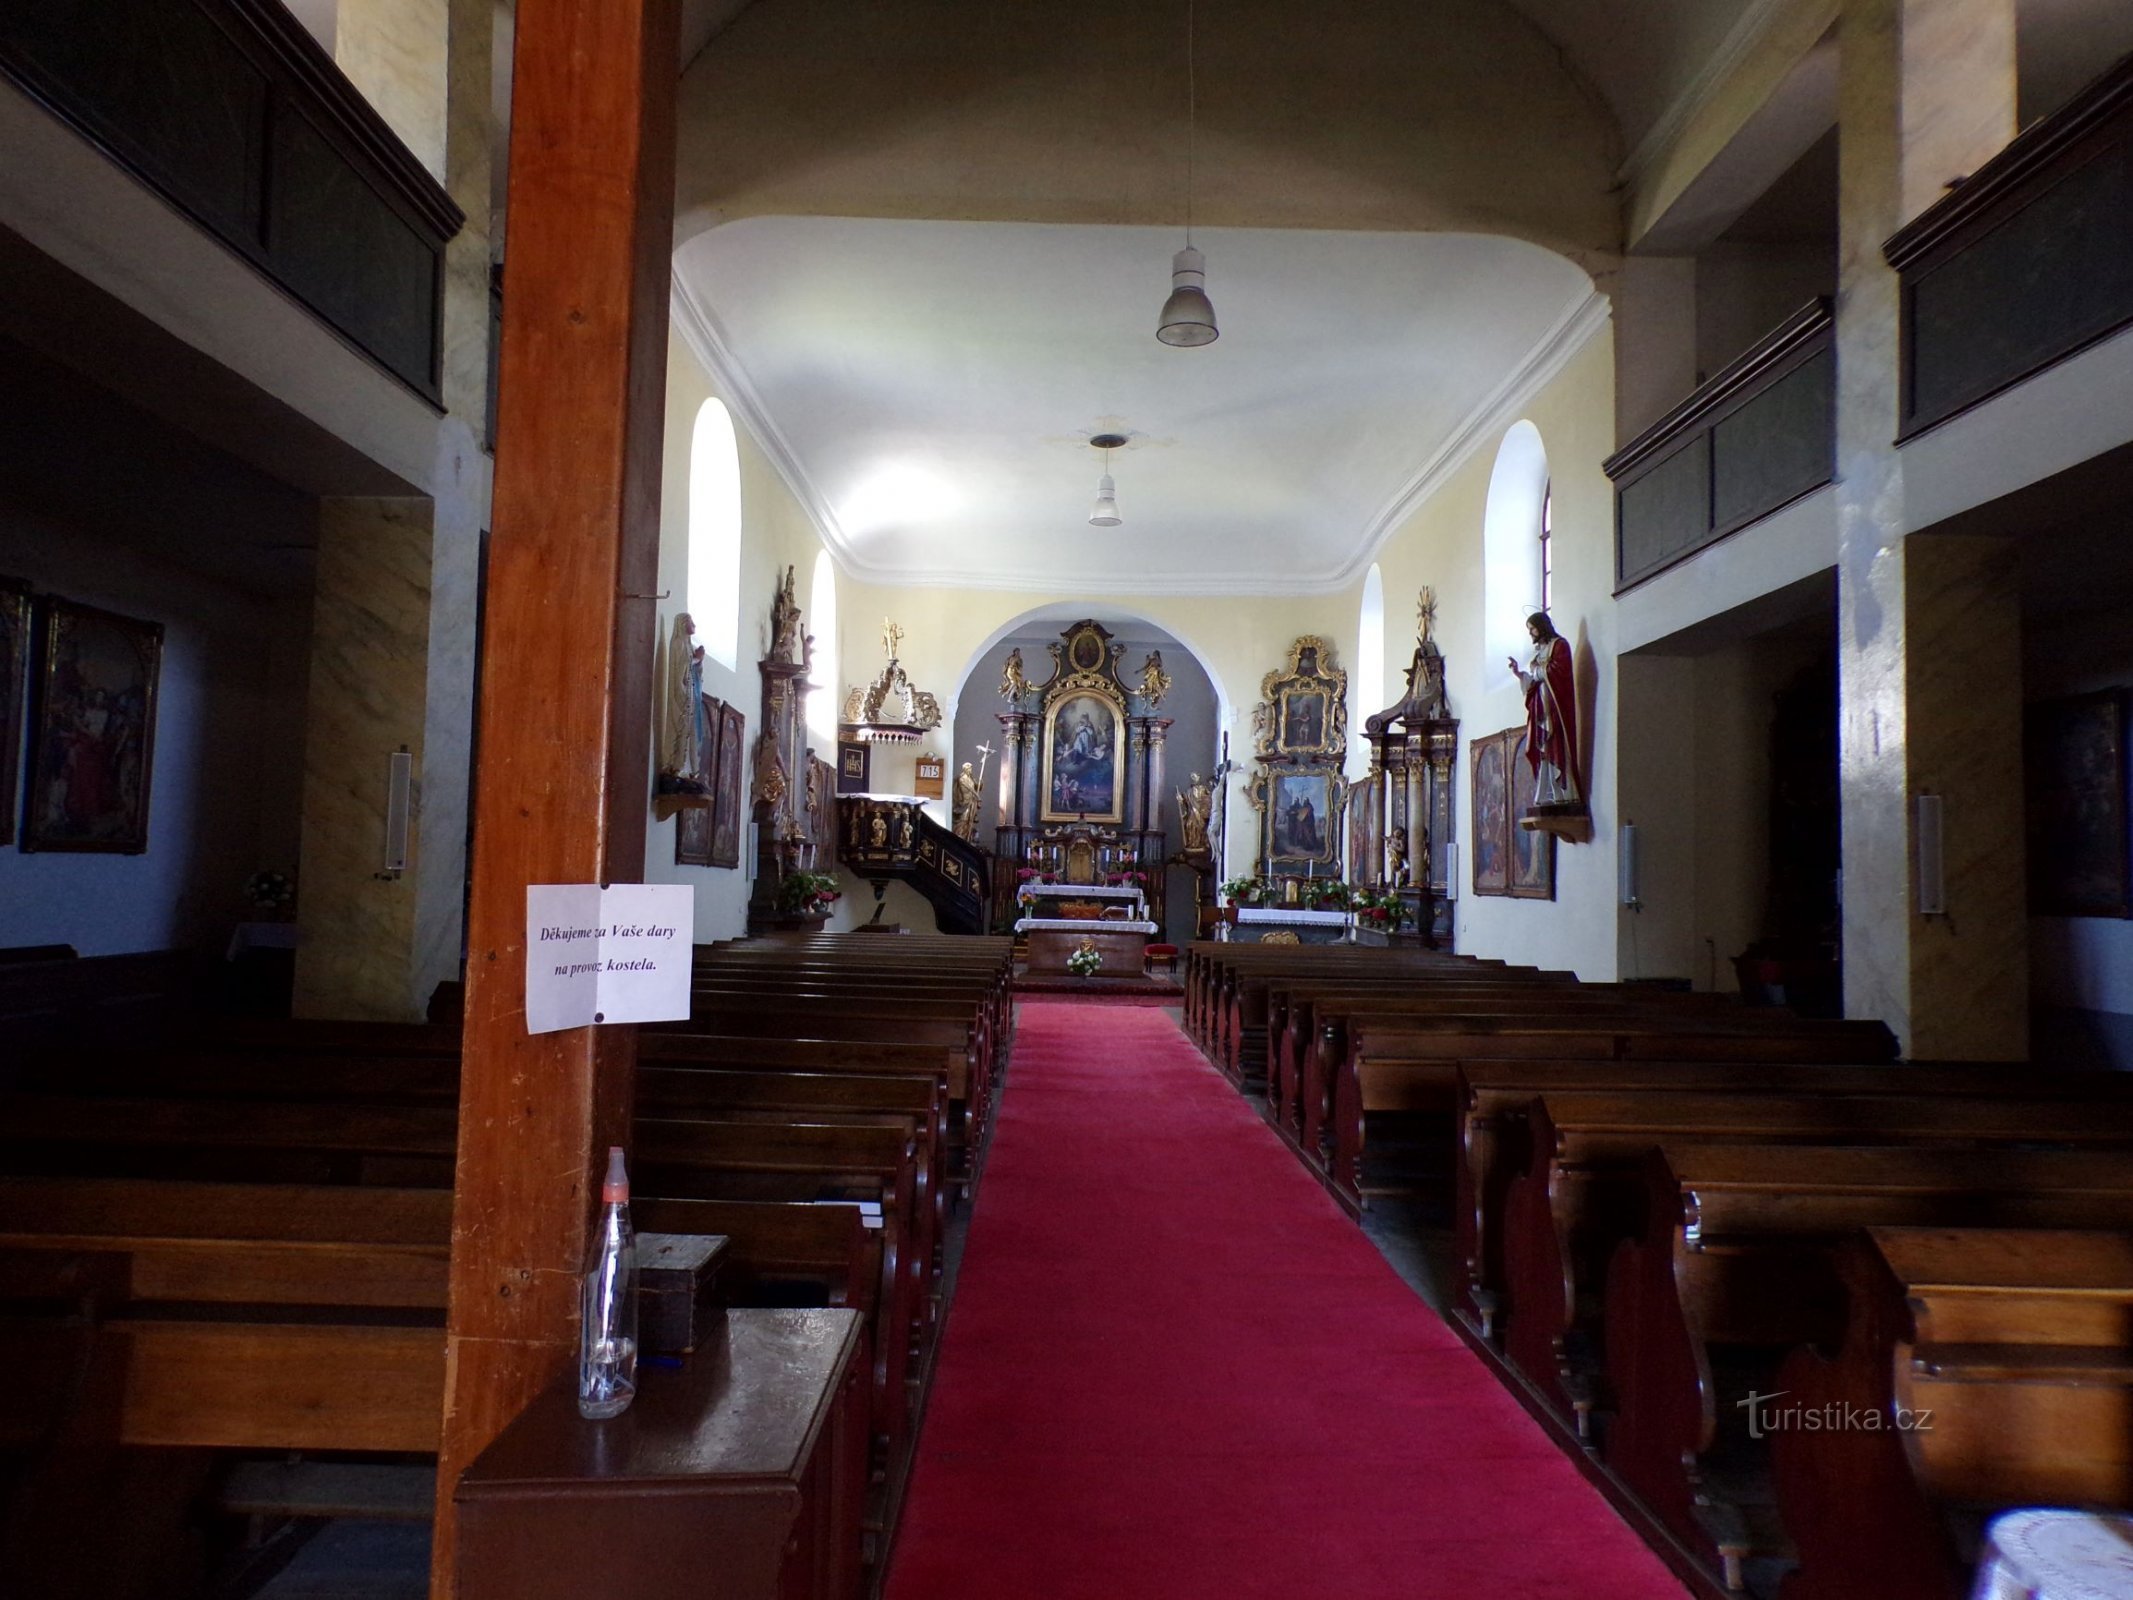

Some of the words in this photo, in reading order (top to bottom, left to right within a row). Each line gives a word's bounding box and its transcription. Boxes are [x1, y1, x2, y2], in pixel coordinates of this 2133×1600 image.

[540, 926, 592, 944] Děkujeme
[594, 928, 606, 938] za
[612, 924, 644, 938] Vaše
[646, 924, 676, 940] dary
[554, 964, 568, 976] na
[570, 961, 603, 978] provoz
[606, 958, 657, 972] kostela.
